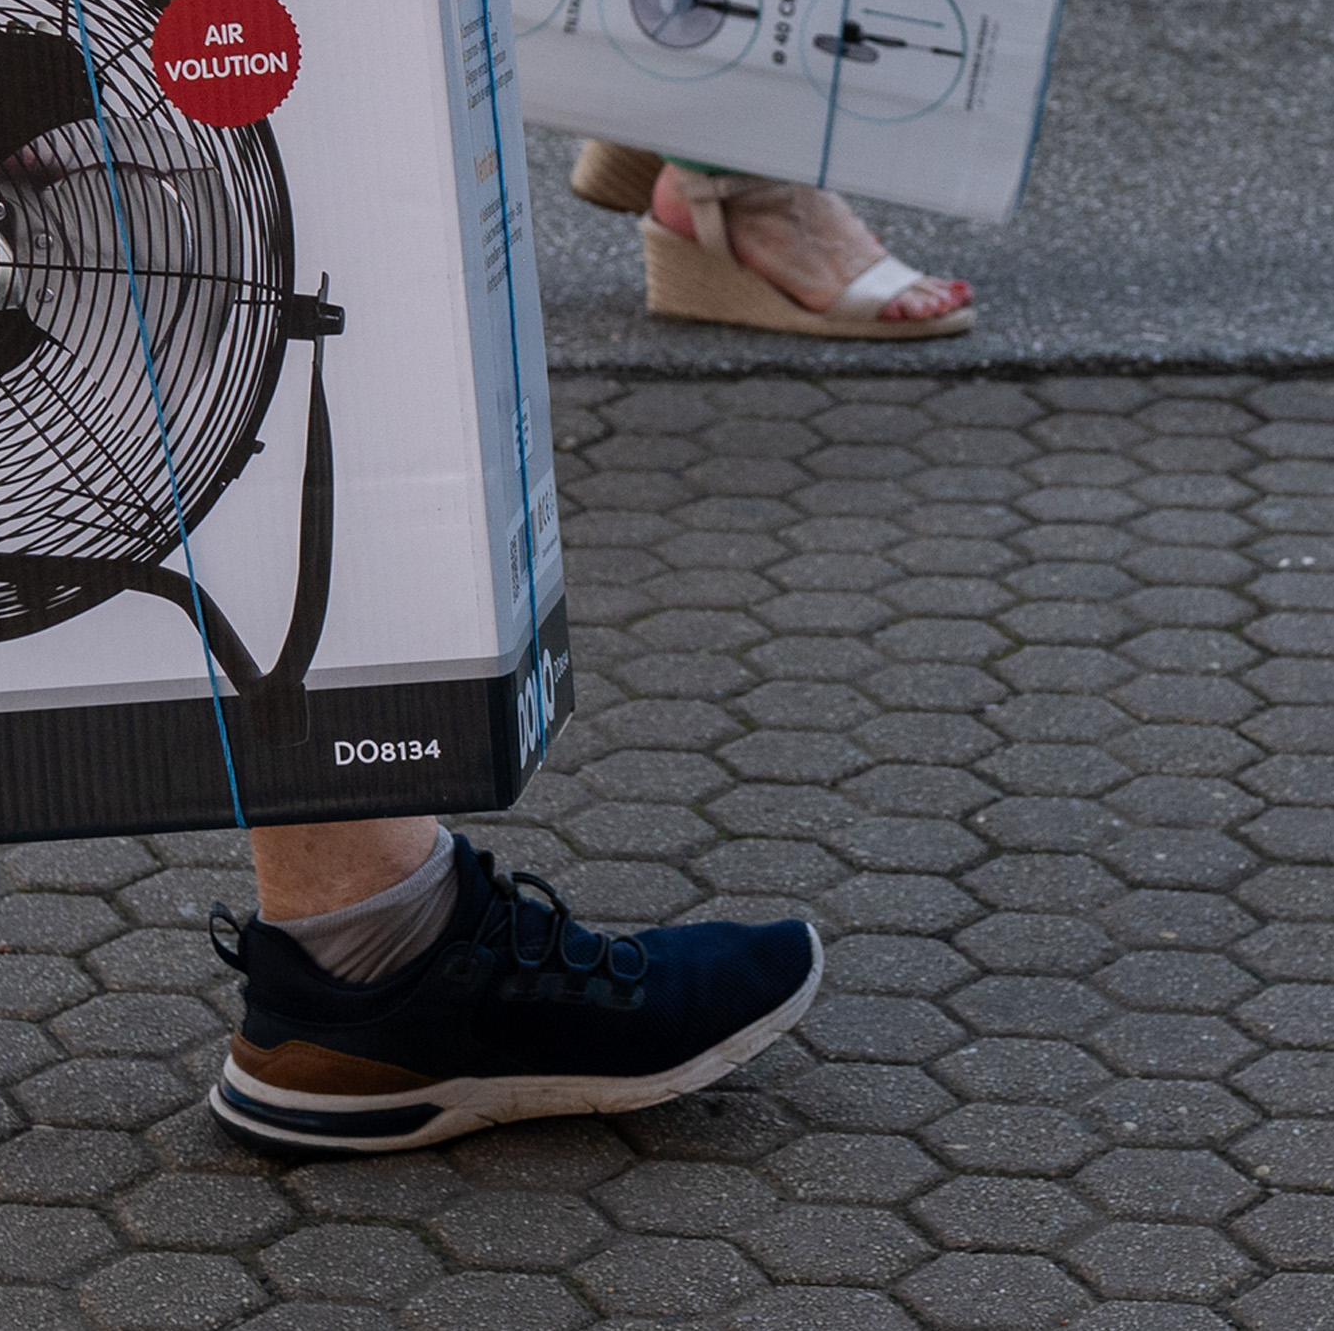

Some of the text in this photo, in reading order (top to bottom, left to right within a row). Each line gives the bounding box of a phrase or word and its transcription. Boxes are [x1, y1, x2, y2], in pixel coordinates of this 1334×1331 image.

[204, 22, 244, 46] AIR
[774, 21, 791, 45] 40
[164, 51, 289, 82] VOLUTION
[333, 738, 442, 766] DO8134
